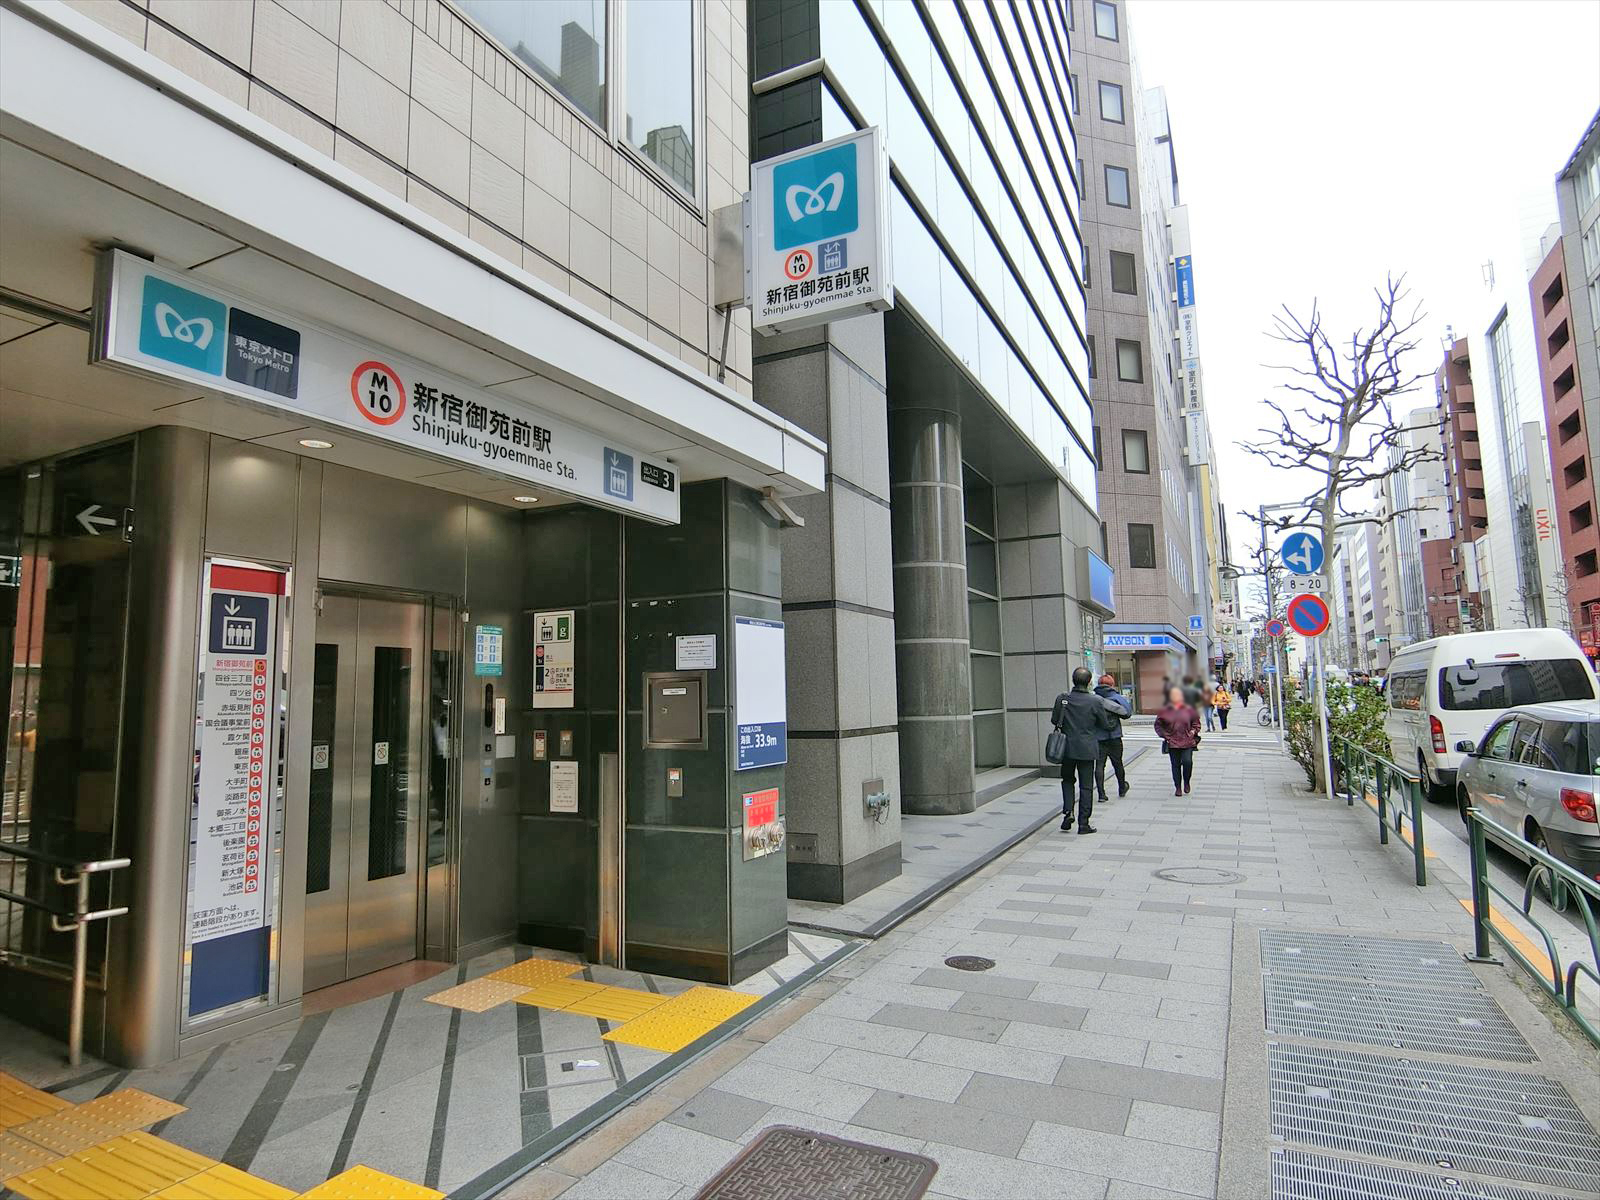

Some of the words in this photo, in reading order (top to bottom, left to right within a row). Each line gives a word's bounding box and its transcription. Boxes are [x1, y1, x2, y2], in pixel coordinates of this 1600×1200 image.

[794, 254, 804, 263] M
[793, 263, 806, 275] 10
[766, 266, 870, 306] 新宿御苑前駅
[762, 289, 854, 317] Shinjuku-gyoemmae
[856, 286, 875, 296] Sta.
[234, 334, 294, 364] 東京メトロ
[238, 350, 264, 366] Tokyo
[266, 357, 290, 373] Metro
[370, 372, 389, 392] M
[368, 390, 392, 414] 10
[412, 382, 552, 455] 新宿御苑前駅
[412, 415, 553, 473] Shinjuku-gyoemmae
[556, 462, 578, 481] Sta.
[662, 472, 670, 488] 3
[1536, 508, 1550, 542] LIXIL
[216, 660, 253, 668] 新宿御苑前
[216, 674, 252, 682] 四谷三丁目
[740, 735, 751, 745] 海抜
[755, 734, 777, 748] 33.9m
[226, 778, 248, 786] 大手町
[225, 792, 247, 801] 淡路町
[216, 807, 247, 817] 御茶ノ水
[208, 822, 246, 833] 本郷三丁目
[223, 837, 245, 847] 後楽園
[222, 852, 245, 862] 茗荷谷
[221, 867, 244, 877] 新大塚
[228, 882, 244, 891] 池袋
[192, 909, 260, 929] 連絡階段があります。
[193, 904, 240, 920] 荻窪方面へは、
